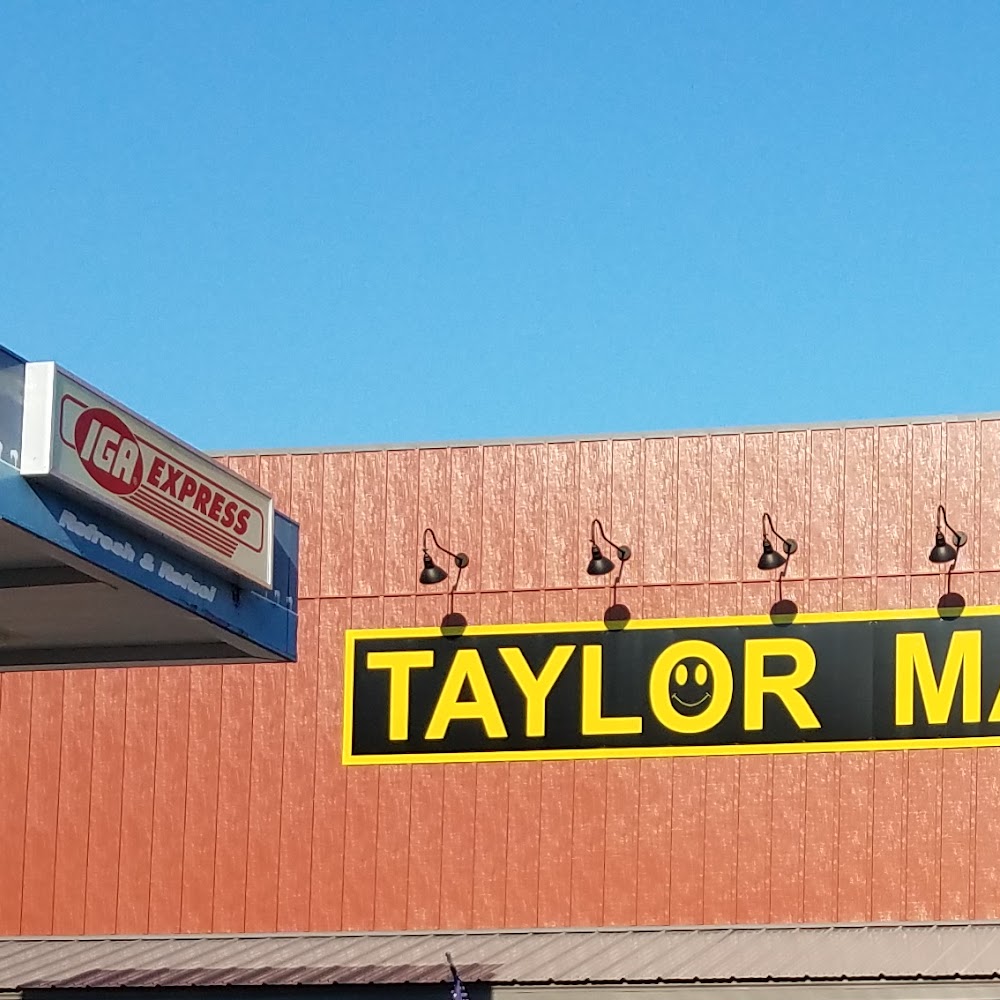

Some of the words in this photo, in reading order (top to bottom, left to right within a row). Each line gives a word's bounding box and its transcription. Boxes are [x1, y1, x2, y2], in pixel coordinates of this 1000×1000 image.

[80, 418, 139, 485] IGA
[146, 455, 251, 536] EXPRESS
[139, 552, 155, 573] &
[367, 637, 821, 741] TAYLOR
